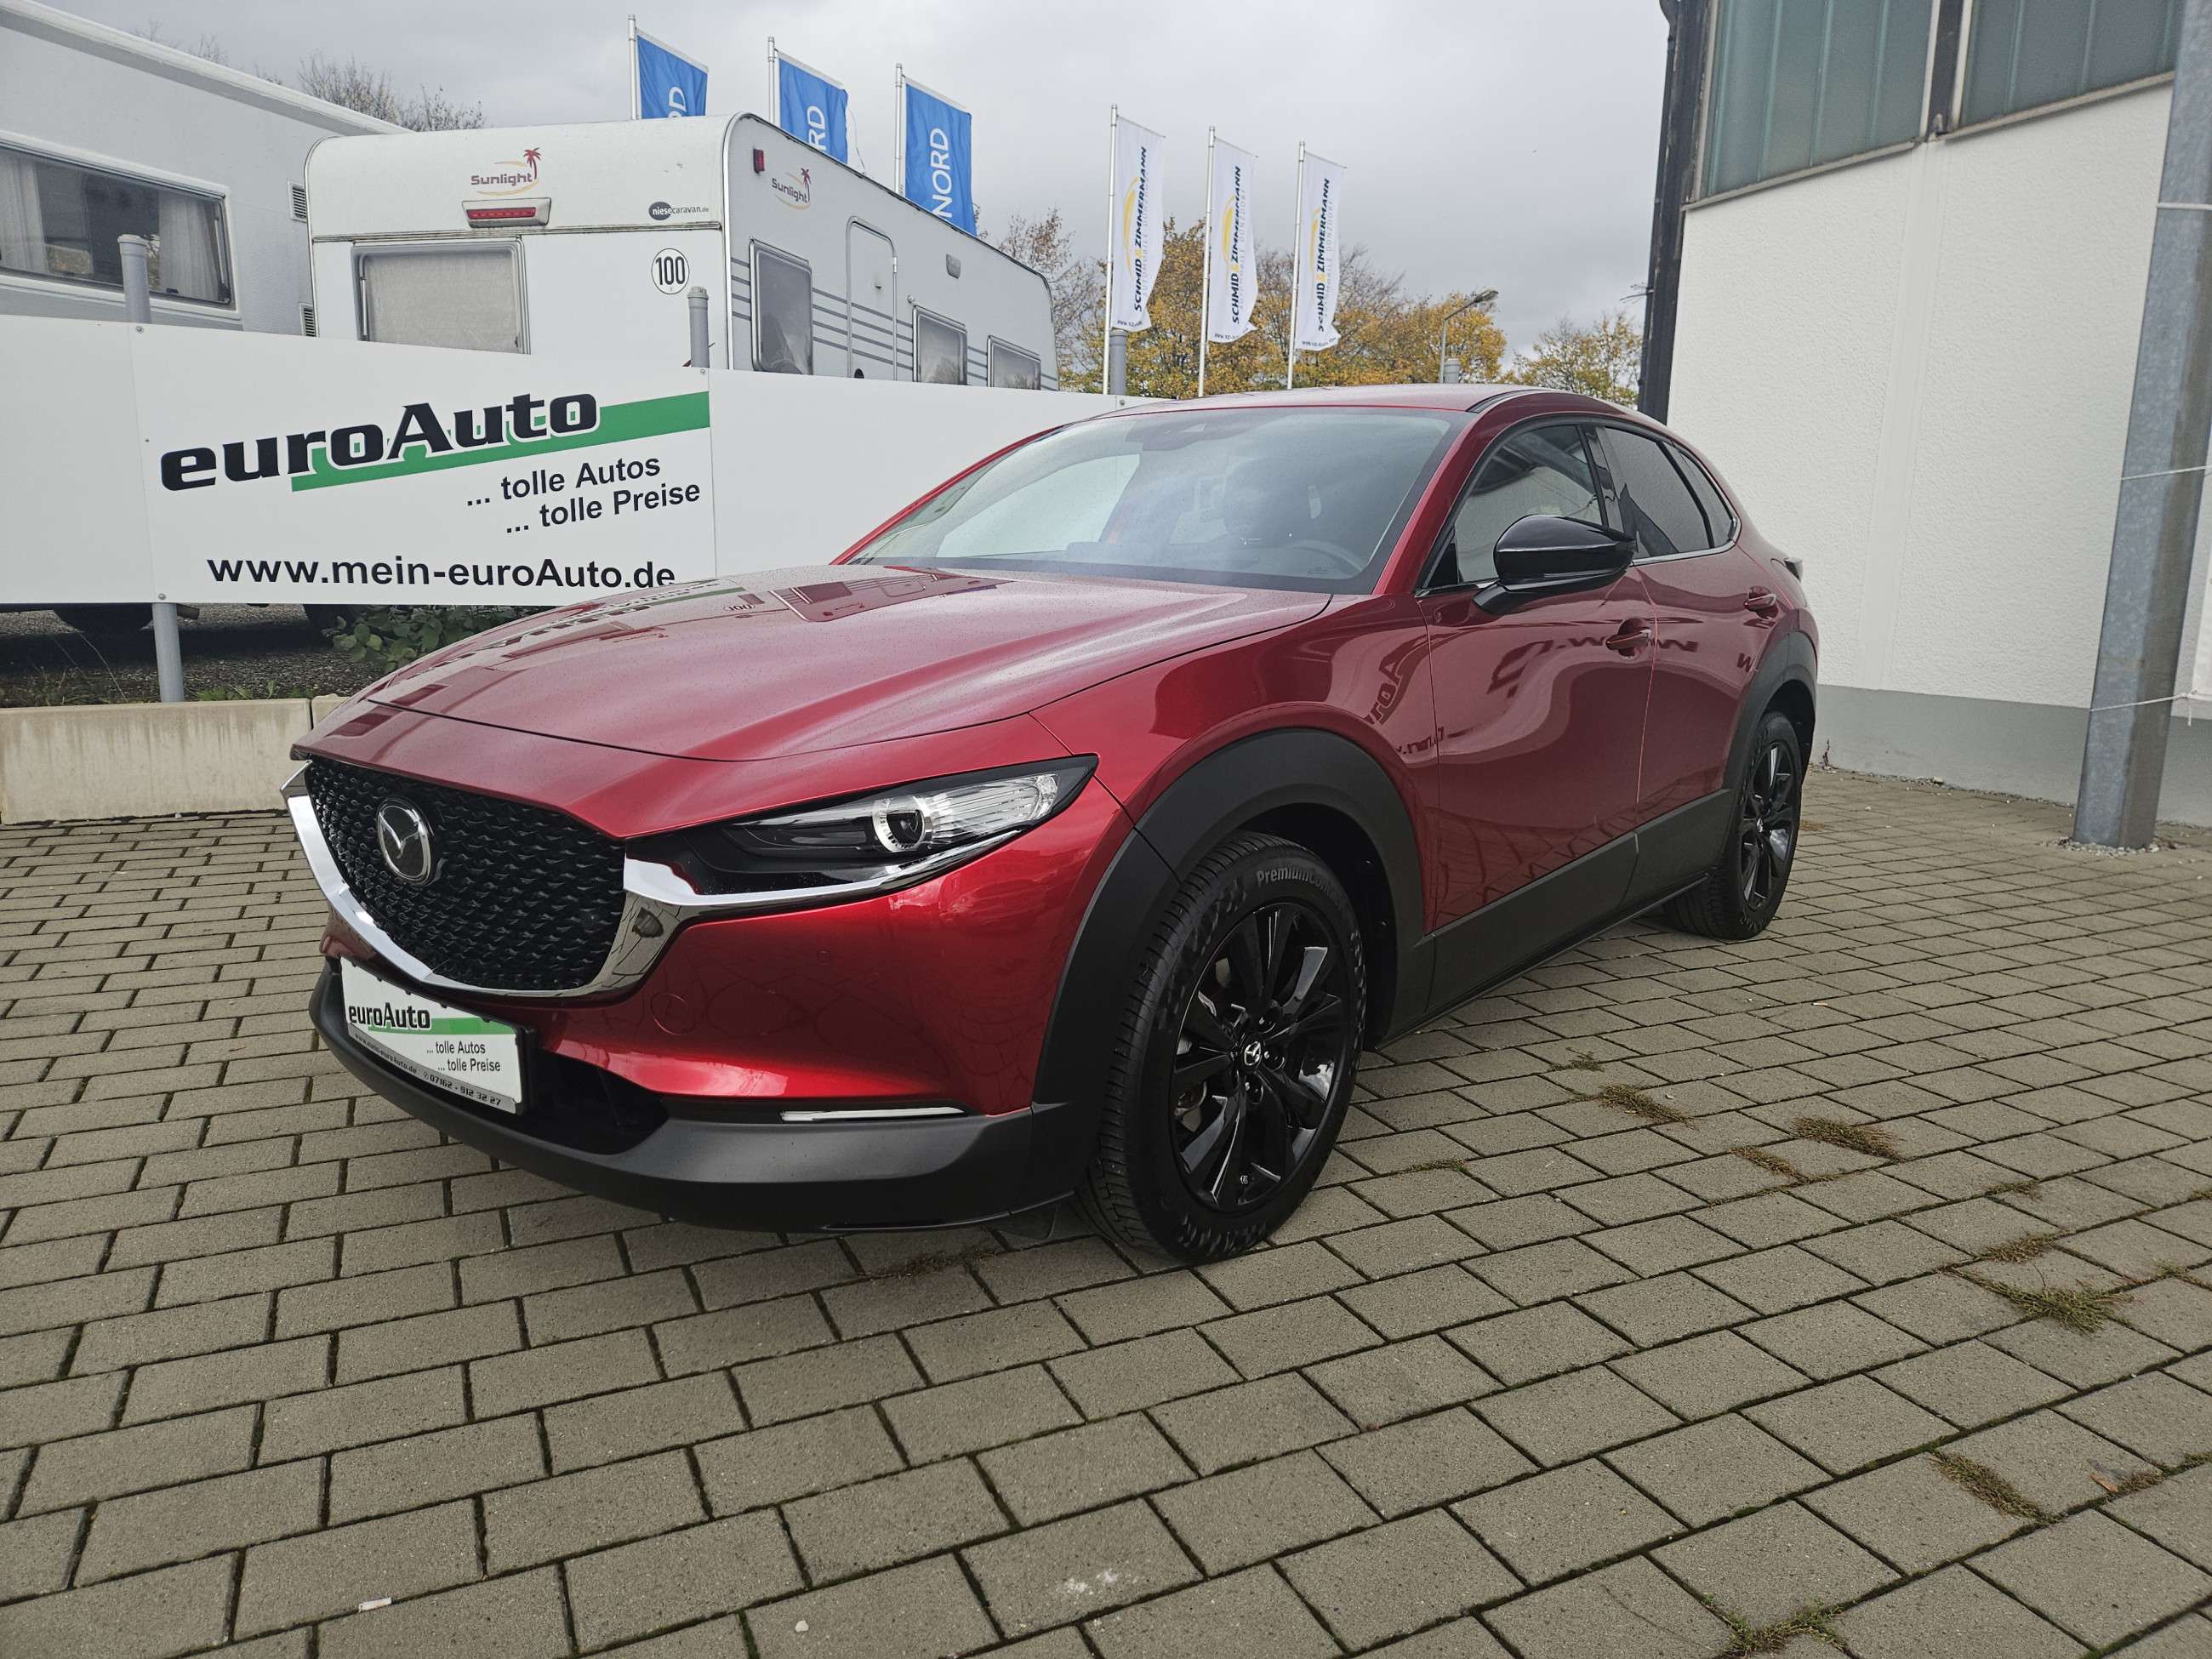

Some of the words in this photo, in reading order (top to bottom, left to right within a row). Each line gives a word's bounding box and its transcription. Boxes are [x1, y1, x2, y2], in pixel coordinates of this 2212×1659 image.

[668, 86, 687, 117] D
[470, 173, 533, 186] Sunlight
[930, 128, 953, 218] NORD
[772, 178, 808, 203] Sunlight
[1135, 145, 1146, 248] ZIMMERMANN
[1317, 178, 1330, 272] ZIMMERMANN
[655, 256, 686, 285] 100
[1134, 258, 1143, 312] SCHMID
[161, 393, 597, 491] euroAuto
[501, 470, 565, 500] tolle
[575, 458, 660, 488] Autos
[539, 497, 602, 527] tolle
[613, 482, 700, 515] Preise
[207, 555, 675, 588] www.mein-euroAuto.de
[348, 1002, 430, 1029] euroAuto
[436, 1040, 454, 1054] tolle
[458, 1040, 486, 1054] Autos
[448, 1058, 467, 1071] tolle
[470, 1058, 501, 1072] Preise
[430, 1075, 453, 1089] 07162
[489, 1096, 501, 1106] 27
